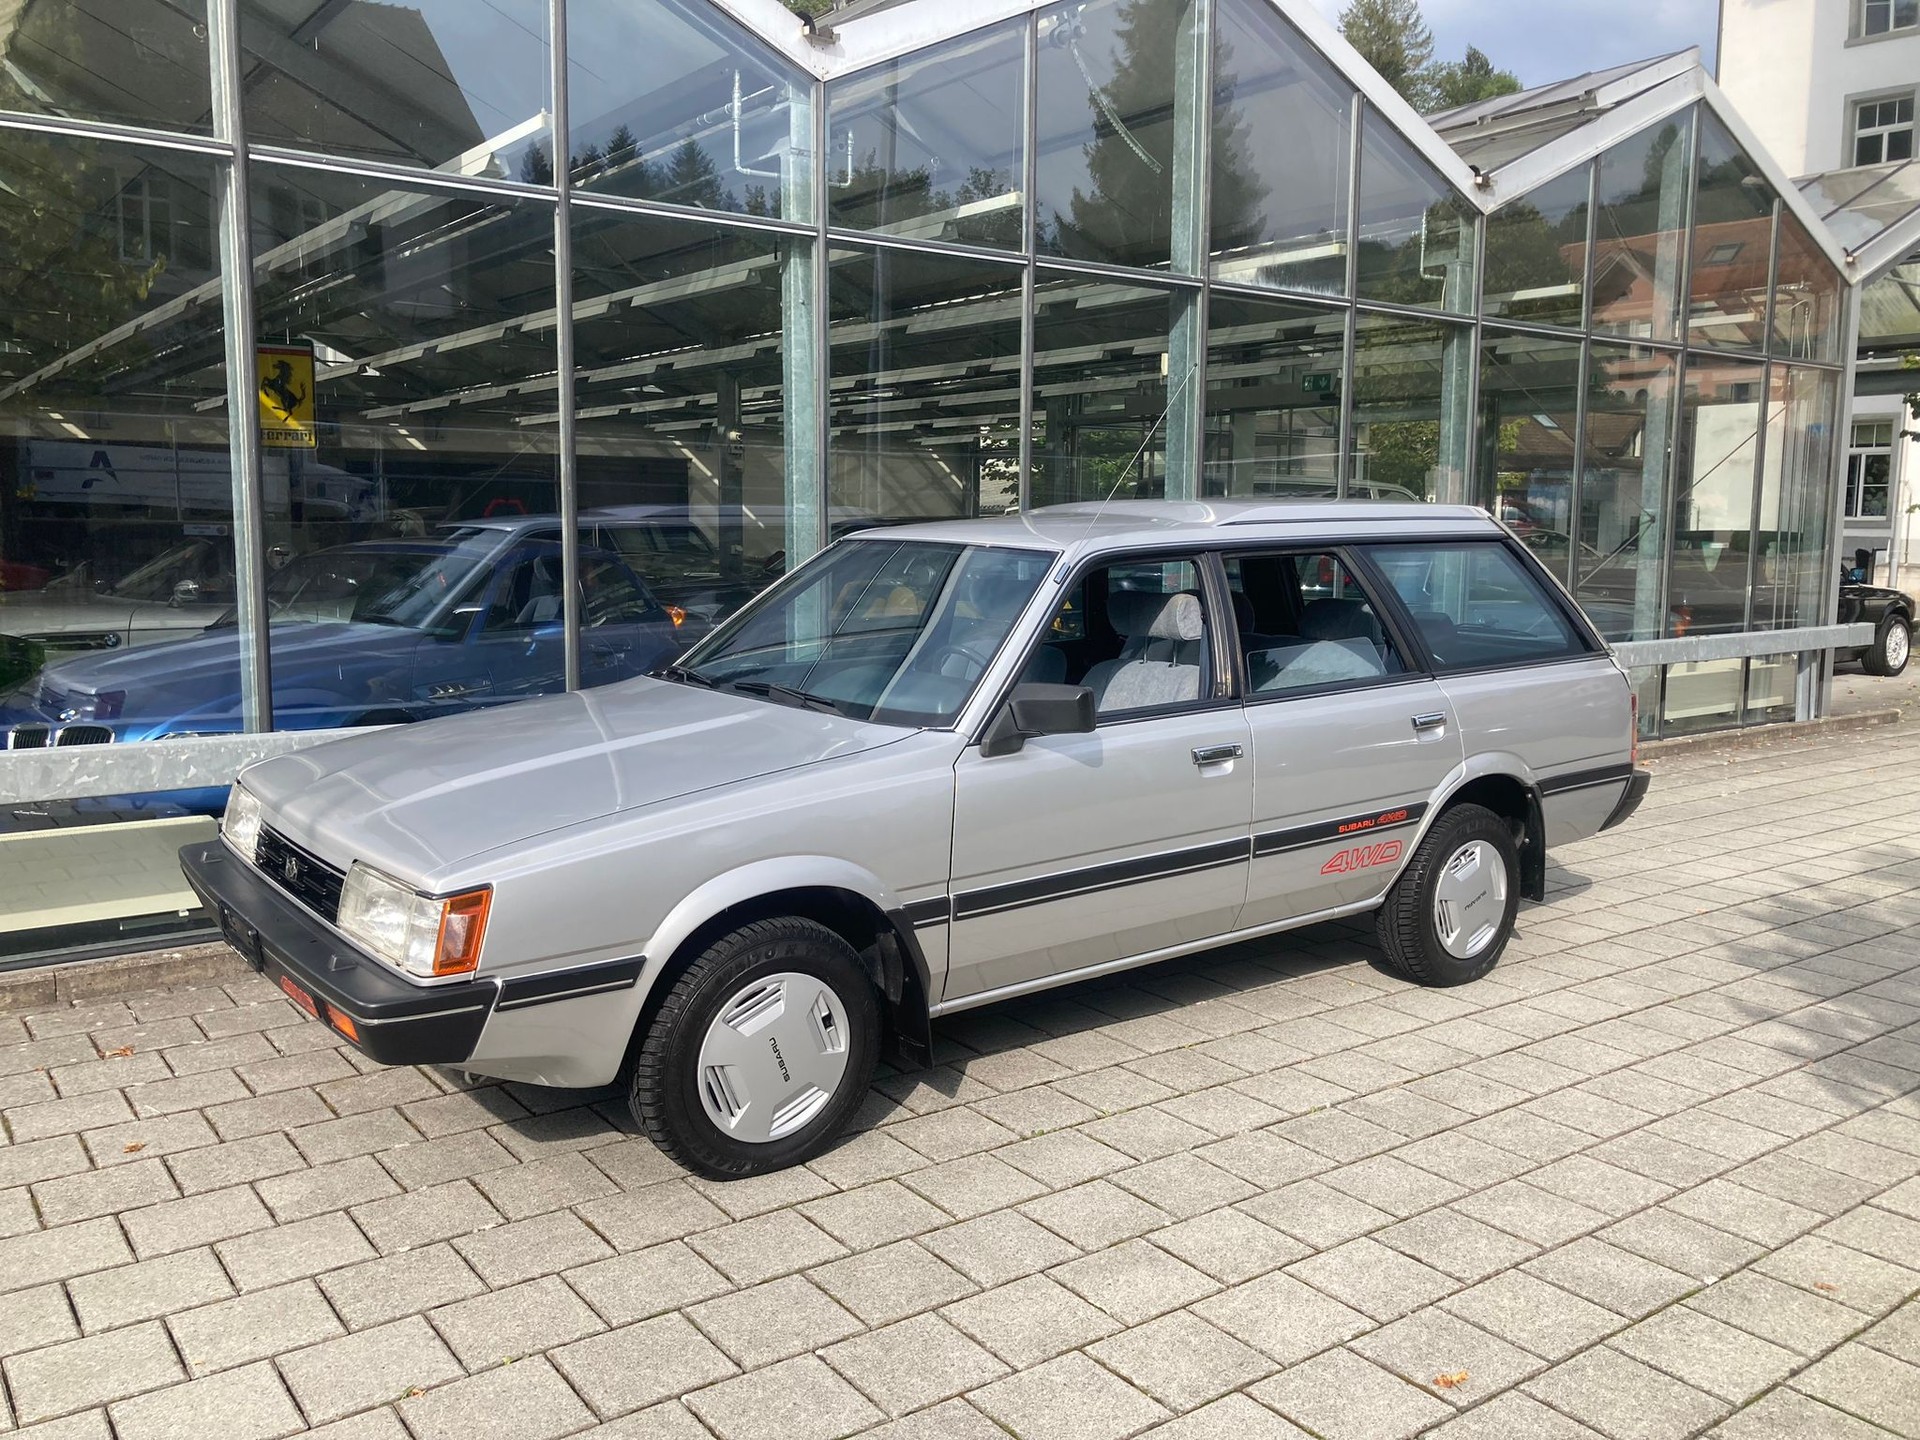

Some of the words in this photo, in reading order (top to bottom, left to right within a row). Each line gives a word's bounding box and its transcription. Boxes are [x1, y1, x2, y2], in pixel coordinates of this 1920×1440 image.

[1338, 819, 1375, 833] SUBARU
[1377, 809, 1408, 824] 4WD
[1320, 839, 1403, 875] 4WD
[769, 1036, 791, 1083] SUBARU
